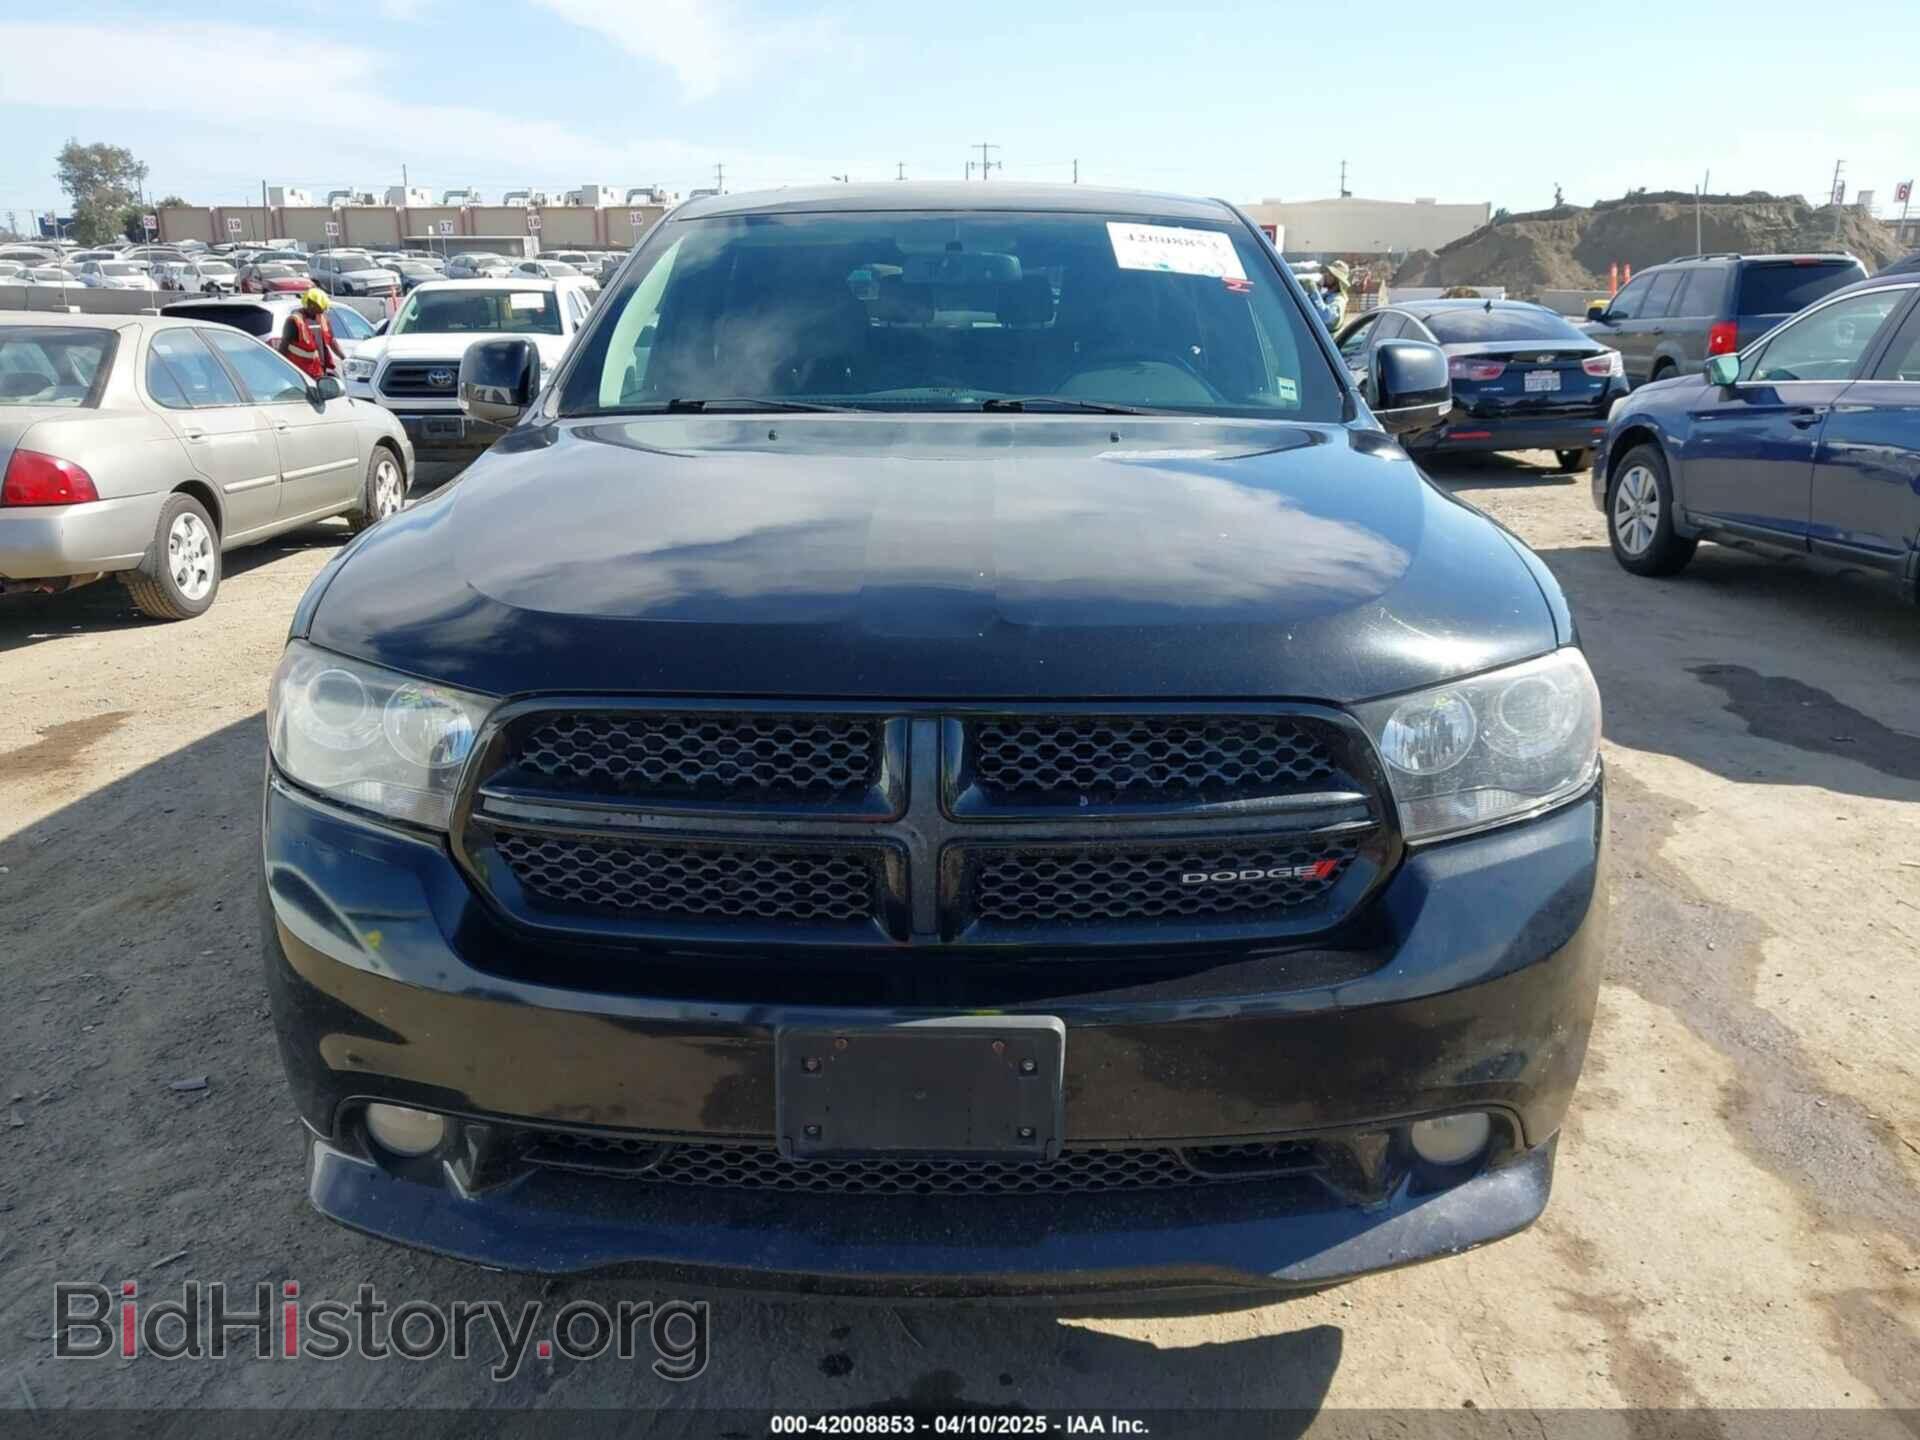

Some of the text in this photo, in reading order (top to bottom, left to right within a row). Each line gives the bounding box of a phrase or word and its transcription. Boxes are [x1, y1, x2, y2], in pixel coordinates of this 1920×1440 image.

[1898, 185, 1908, 201] 6
[631, 213, 642, 224] 15
[440, 222, 452, 232] 17
[1181, 864, 1319, 884] DODGE
